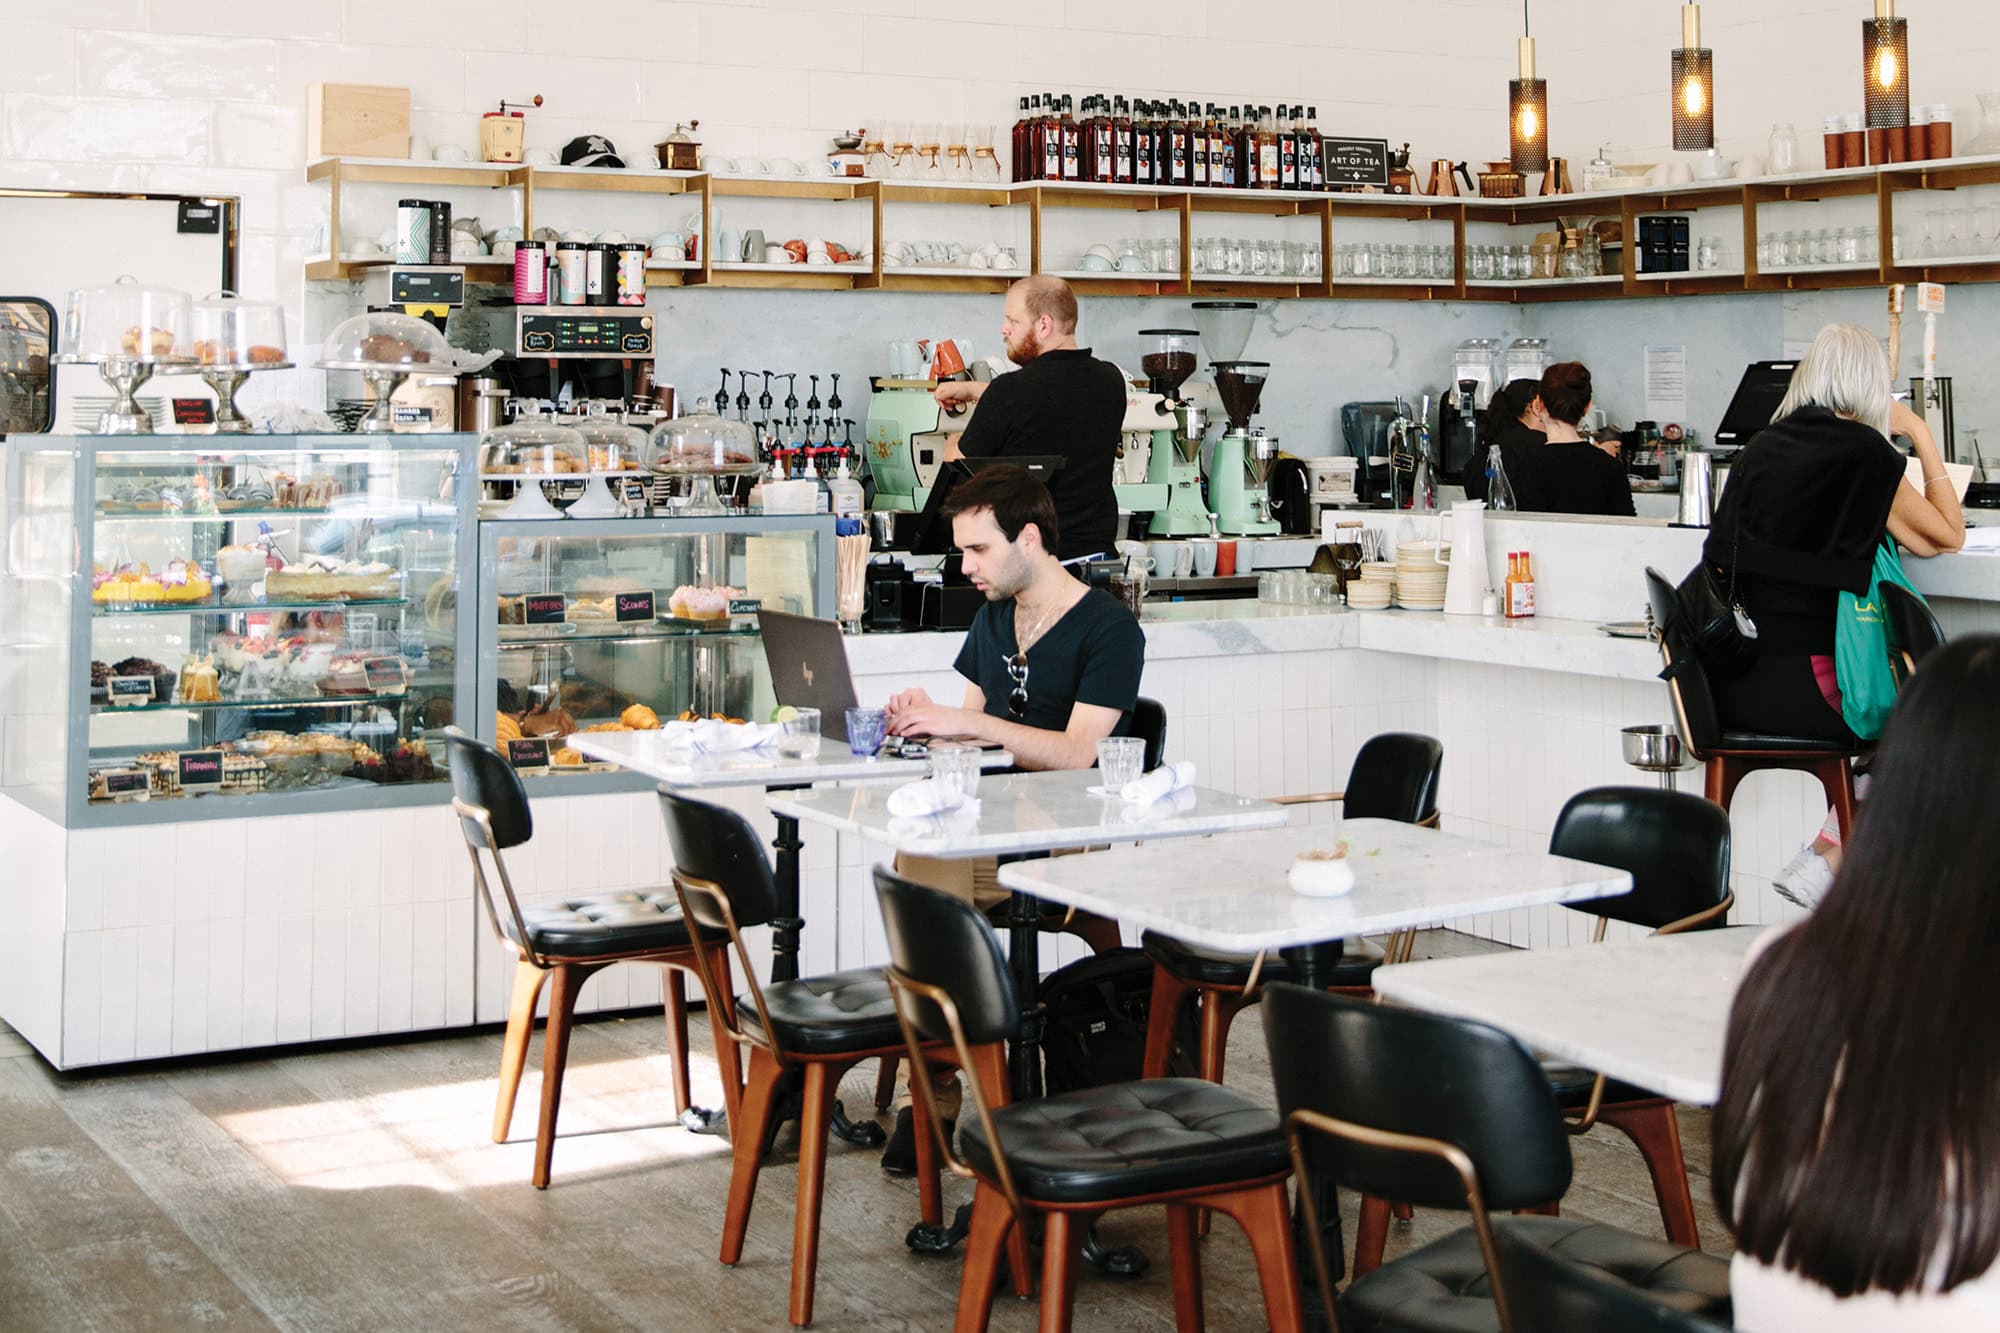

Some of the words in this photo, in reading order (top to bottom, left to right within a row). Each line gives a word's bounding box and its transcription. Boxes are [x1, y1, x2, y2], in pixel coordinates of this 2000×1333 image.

[1331, 156, 1347, 164] ART
[1349, 157, 1361, 165] OF
[1364, 157, 1380, 166] TEA
